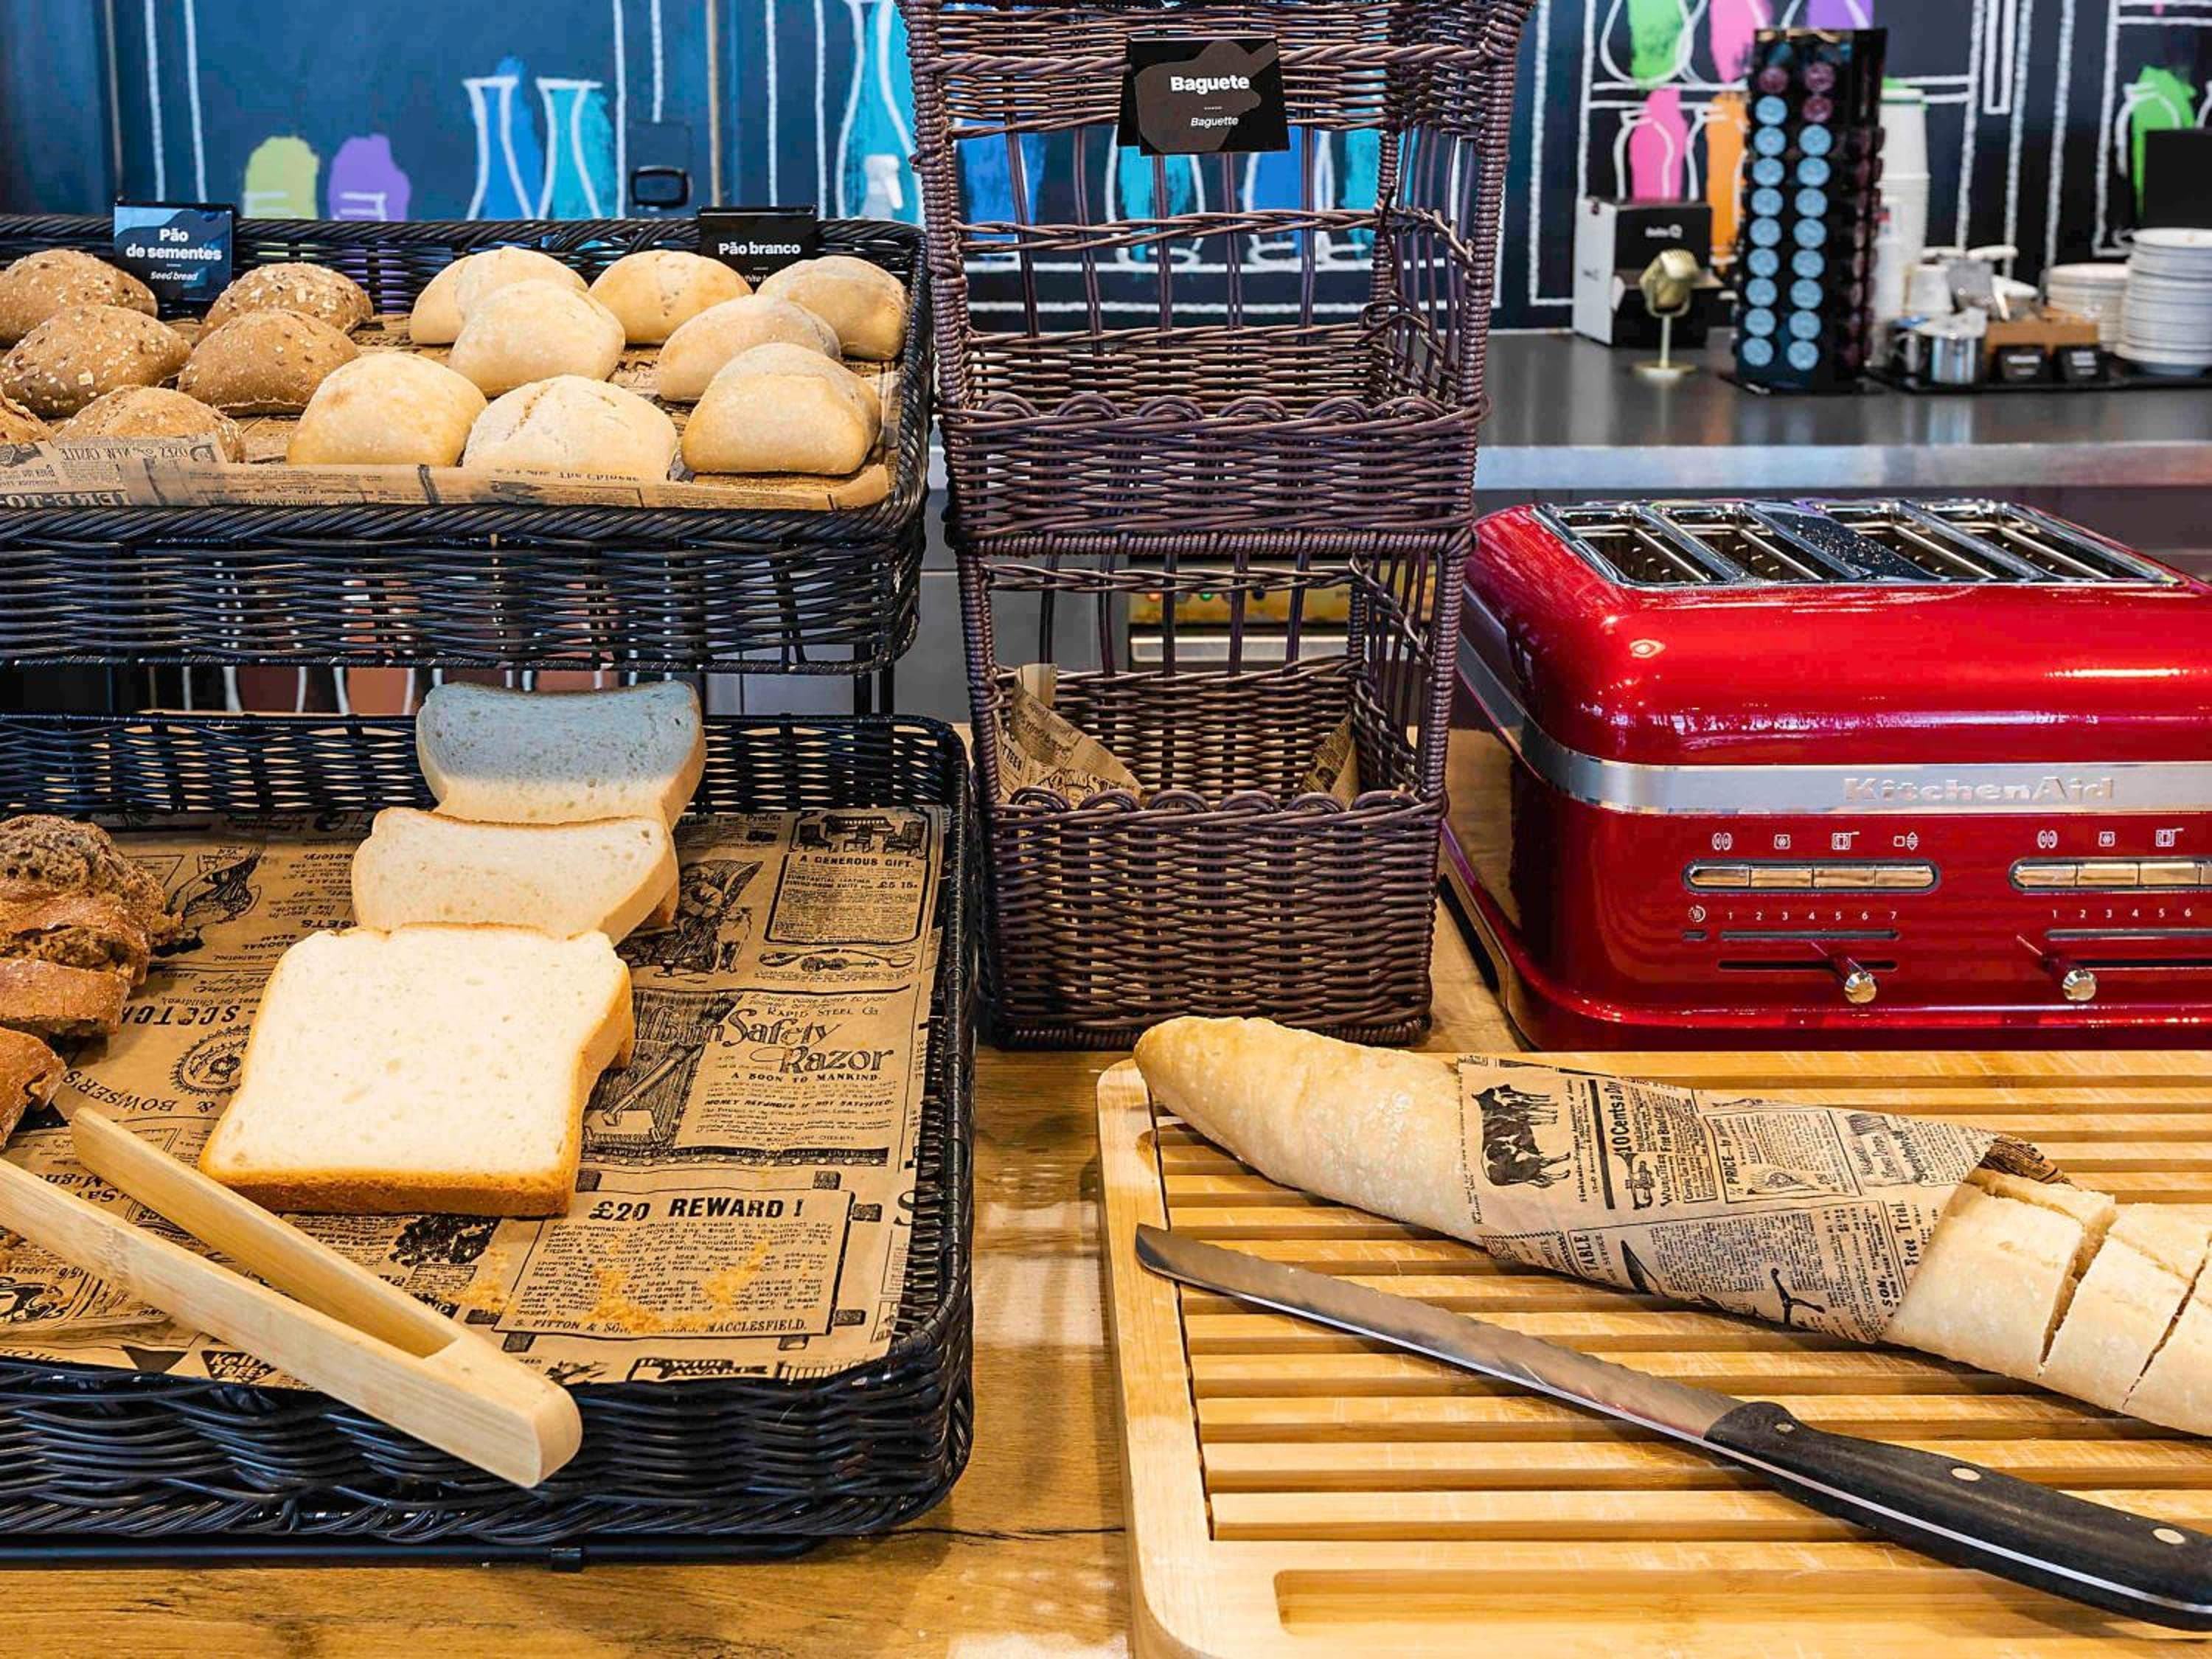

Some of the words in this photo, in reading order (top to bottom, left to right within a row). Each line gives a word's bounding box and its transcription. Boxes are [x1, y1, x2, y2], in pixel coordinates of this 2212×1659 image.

[1170, 75, 1250, 95] Baguete
[1191, 116, 1239, 129] Baguette
[159, 228, 189, 242] Pão
[126, 243, 145, 257] de
[147, 246, 222, 260] sementes
[718, 242, 747, 254] Pão
[749, 241, 801, 254] branco
[150, 271, 173, 280] Seed
[173, 271, 199, 280] bread
[1844, 776, 2113, 801] KitchenAid
[815, 856, 878, 866] GENEROUS
[885, 858, 914, 868] GIFT.
[1728, 911, 1733, 920] 1
[1756, 911, 1762, 920] 2
[1781, 911, 1788, 920] 3
[1809, 911, 1815, 920] 4
[1835, 911, 1842, 920] 5
[1862, 911, 1868, 920] 6
[1891, 911, 1897, 920] 7
[2053, 909, 2058, 919] 1
[2080, 909, 2086, 919] 2
[2106, 909, 2112, 918] 3
[2132, 908, 2138, 917] 4
[2159, 908, 2165, 918] 5
[2185, 908, 2191, 917] 6
[723, 1008, 841, 1047] Safety
[774, 1046, 894, 1074] Razor
[748, 1074, 783, 1082] BOON
[63, 1070, 178, 1112] BOWSER'S
[196, 1101, 215, 1113] &
[1609, 1102, 1630, 1135] Cents
[1612, 1137, 1632, 1152] 10
[589, 1201, 650, 1221] £20
[668, 1197, 784, 1217] REWARD
[1904, 1239, 1919, 1267] Free
[212, 1365, 268, 1377] TREES
